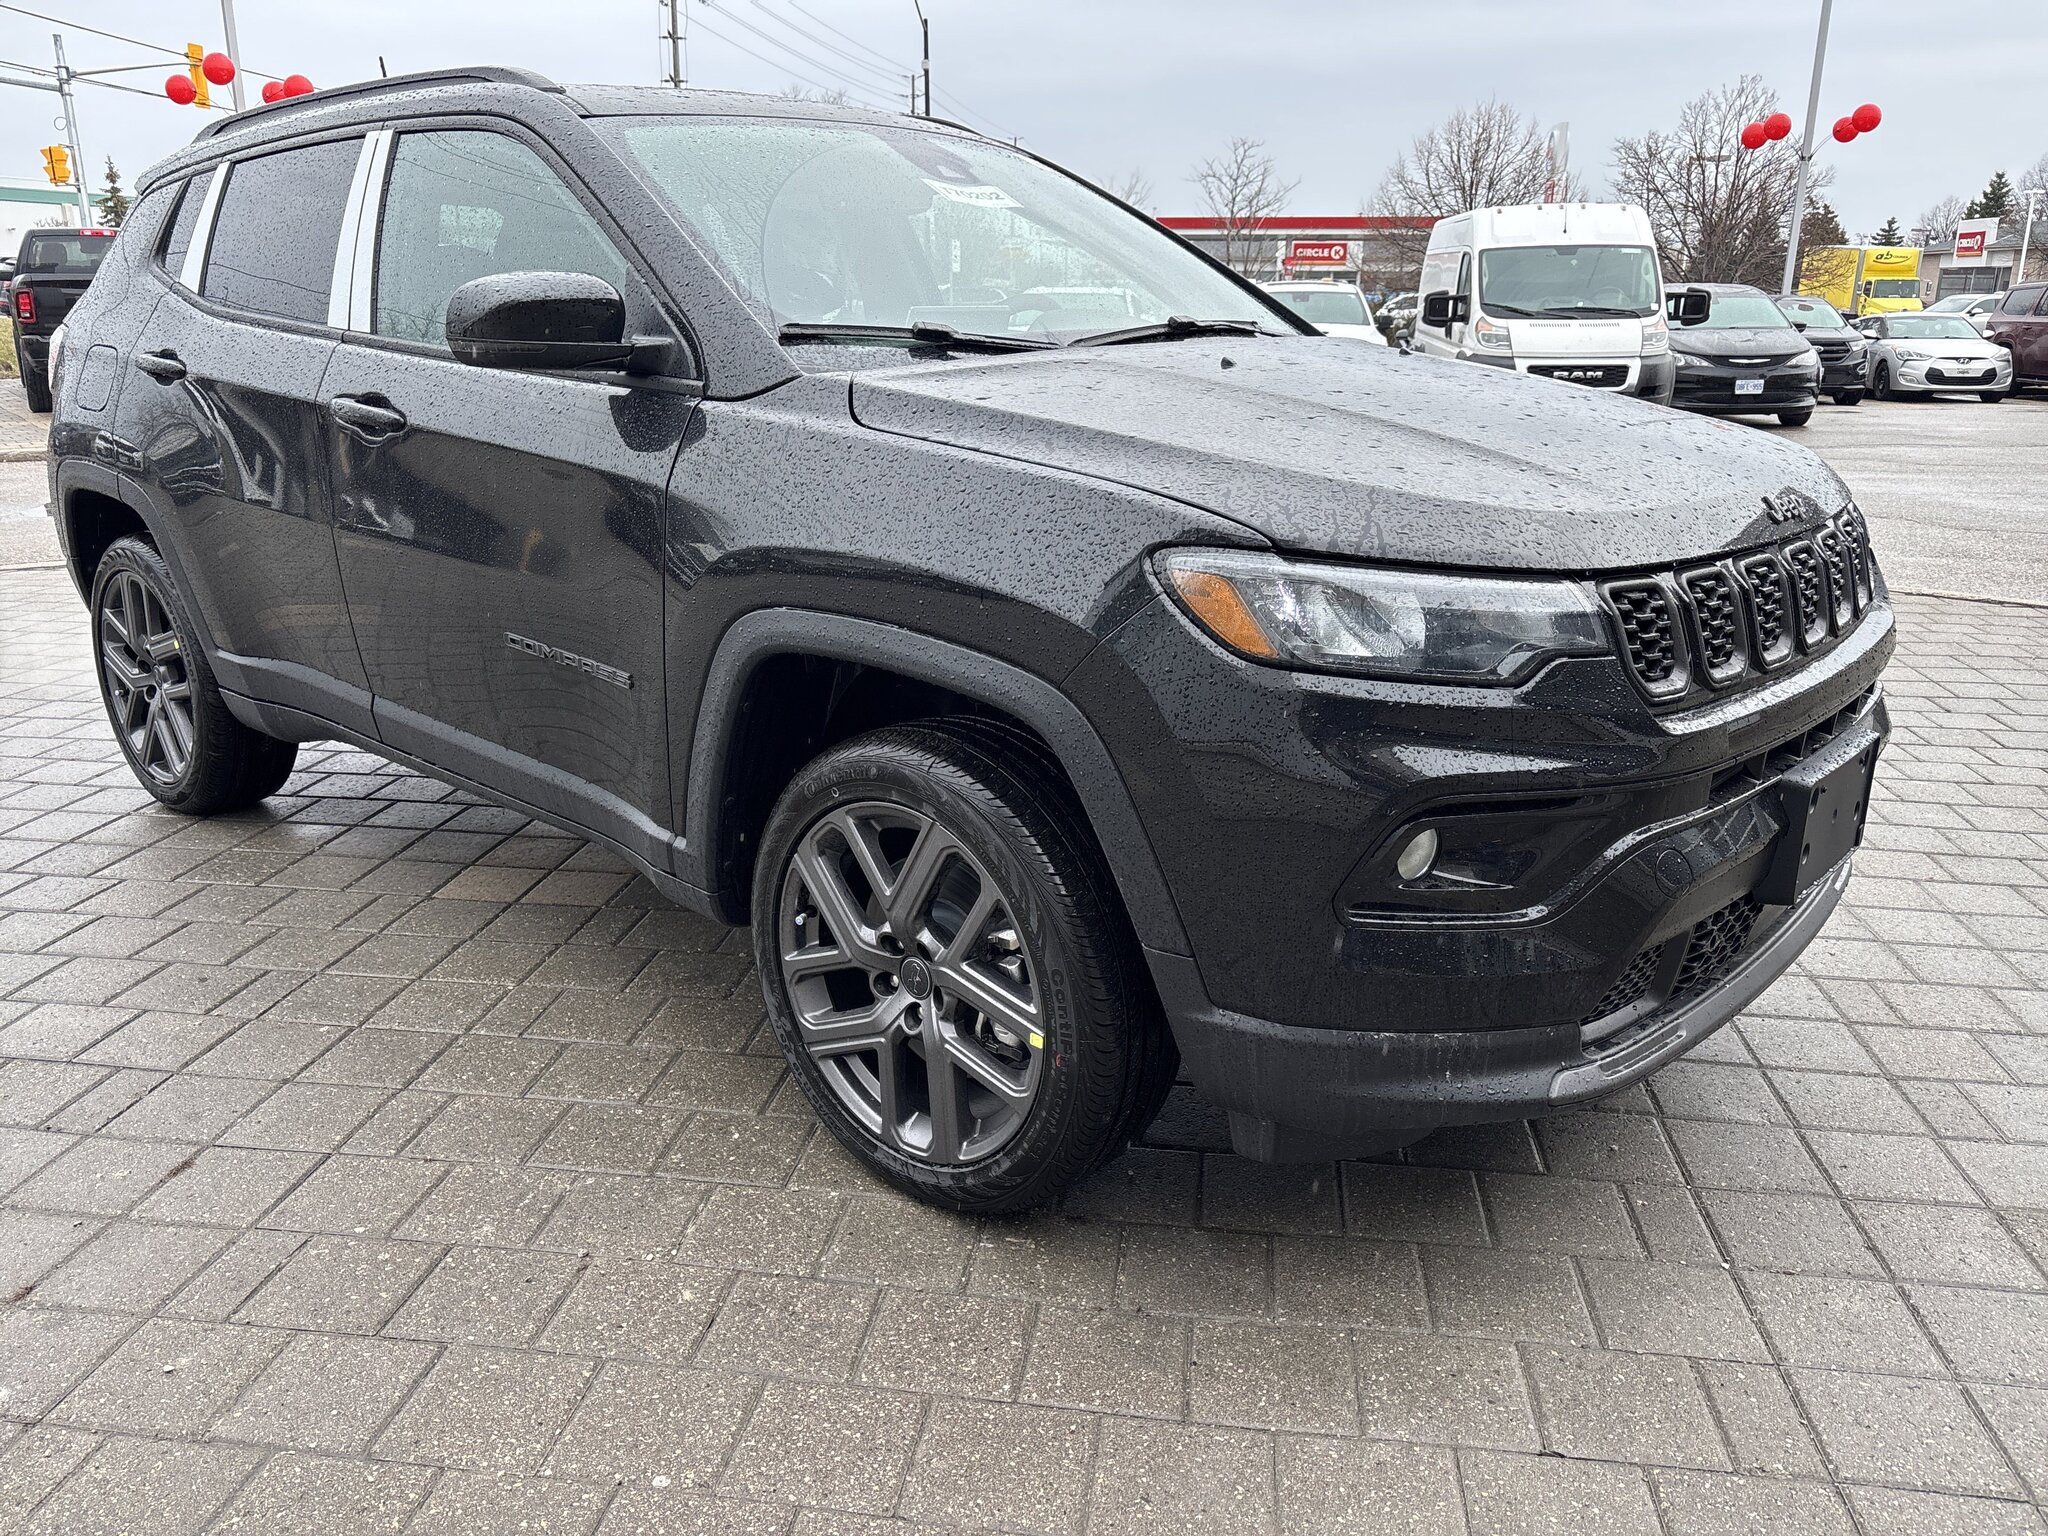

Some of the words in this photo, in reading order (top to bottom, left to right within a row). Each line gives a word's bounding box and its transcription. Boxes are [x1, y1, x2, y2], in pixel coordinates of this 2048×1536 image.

[1296, 248, 1330, 258] CIRCLE
[1553, 371, 1604, 379] RAM
[1761, 494, 1808, 523] Jeep
[502, 631, 634, 690] COMPASS
